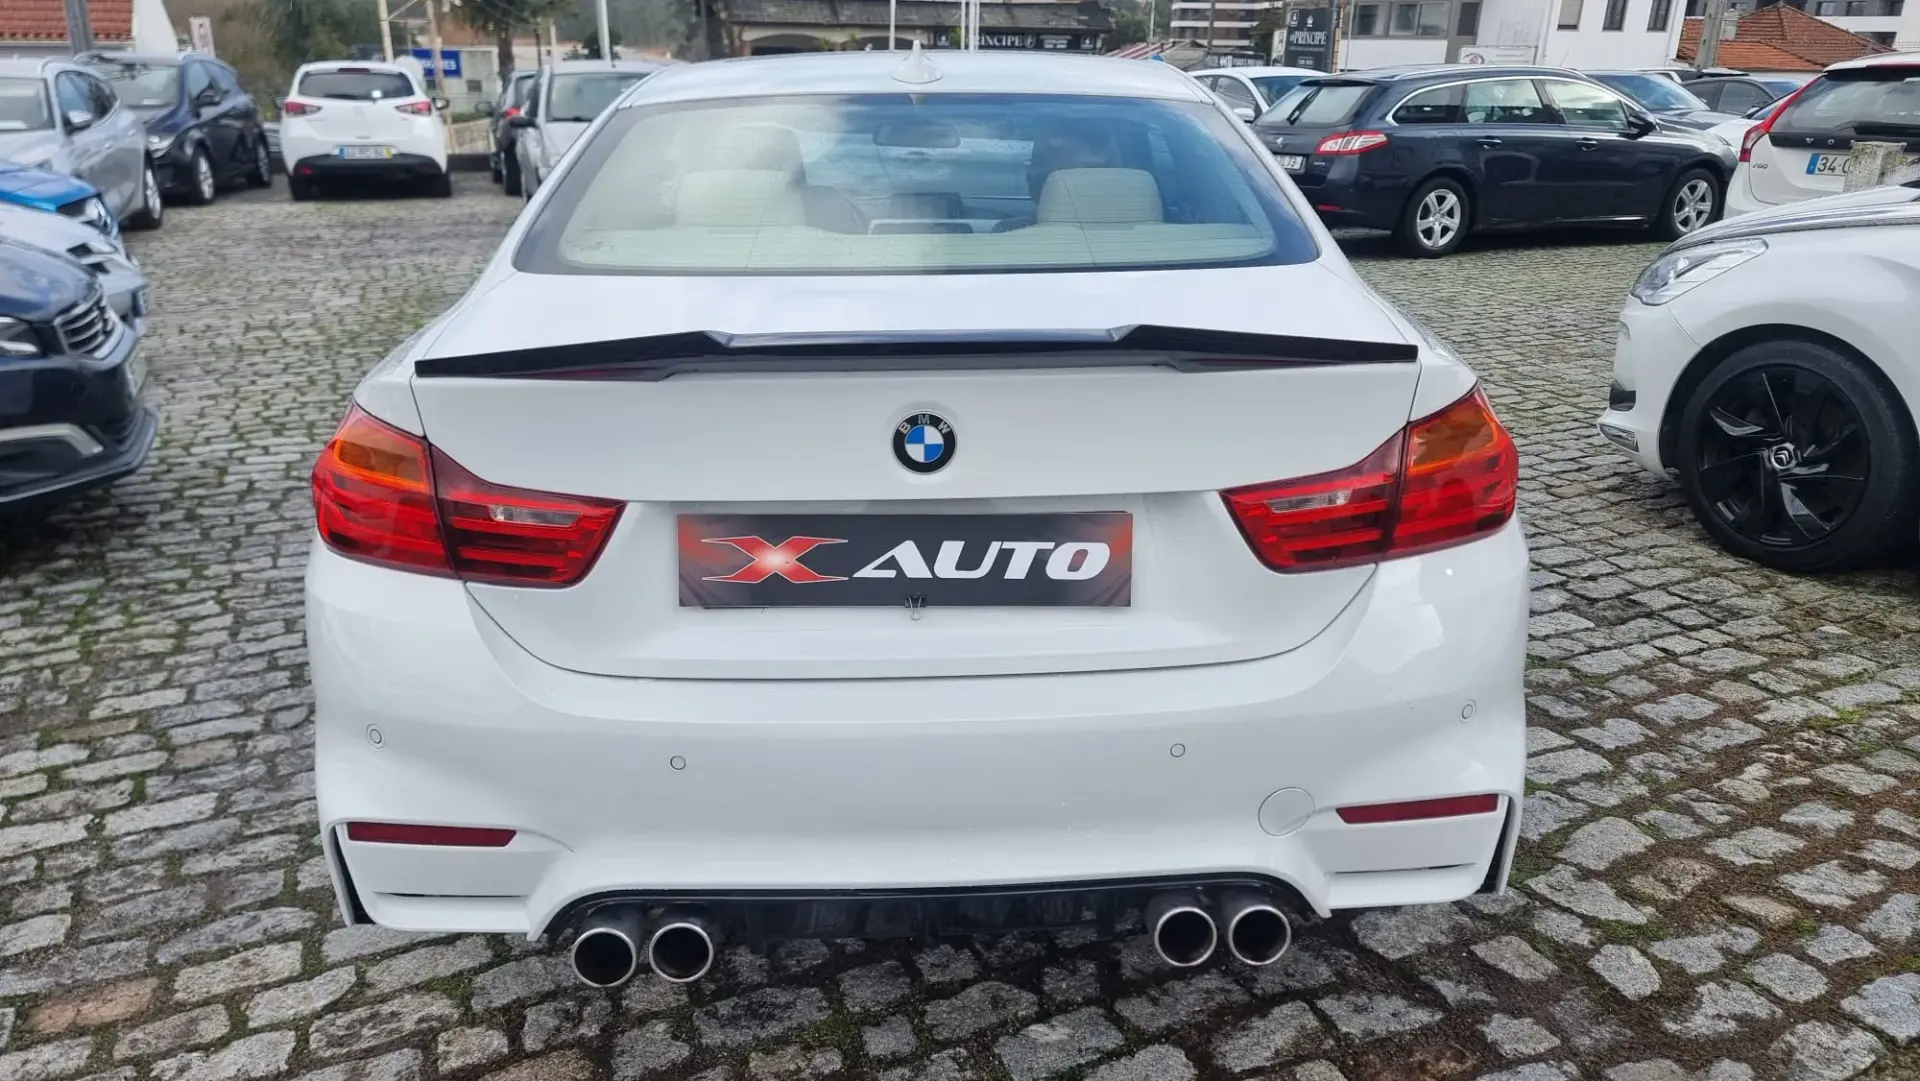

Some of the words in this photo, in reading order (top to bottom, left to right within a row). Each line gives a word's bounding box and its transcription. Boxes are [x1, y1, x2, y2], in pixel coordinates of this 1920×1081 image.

[898, 414, 951, 435] BMW
[701, 536, 849, 584] X
[852, 540, 1111, 580] AUTO
